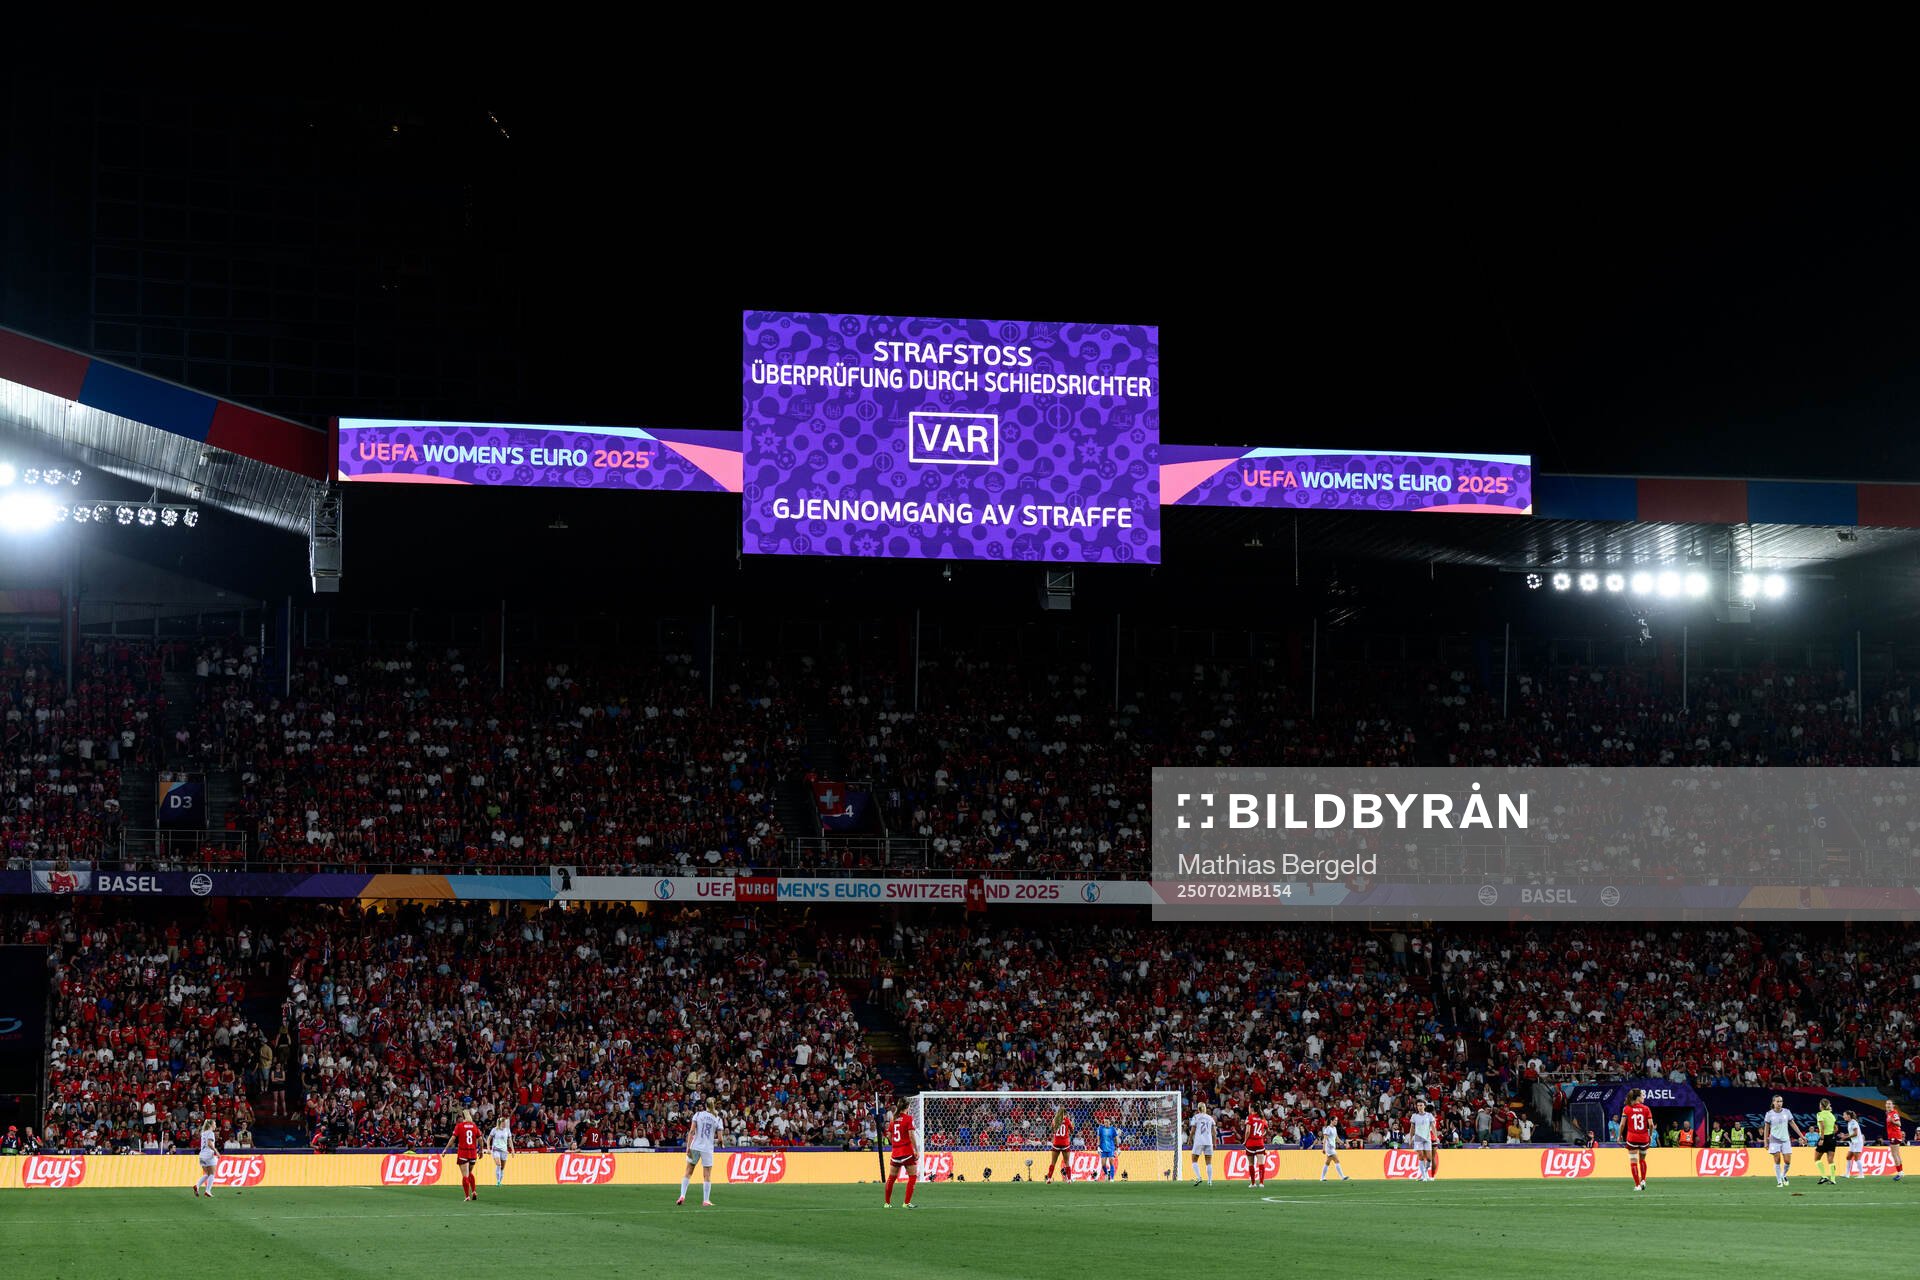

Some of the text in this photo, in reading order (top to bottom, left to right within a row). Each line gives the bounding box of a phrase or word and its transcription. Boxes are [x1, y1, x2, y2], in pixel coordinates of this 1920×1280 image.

[873, 341, 1033, 367] STRAFSTOSS
[751, 359, 1152, 397] ÜBERPRÜFUNG DURCH SCHIEDSRICHTER
[917, 423, 989, 453] VAR
[359, 442, 419, 462] UEFA
[423, 444, 524, 465] WOMEN'S
[530, 448, 588, 467] EURO
[1243, 469, 1298, 488] UEFA
[1301, 471, 1394, 491] WOMEN'S
[1399, 473, 1452, 492] EURO
[772, 497, 1133, 529] GJENNOMGANG AV STRAFFE
[170, 794, 193, 809] D3
[98, 876, 162, 893] BASEL
[697, 882, 736, 898] UEF
[834, 883, 882, 899] EURO
[1015, 884, 1059, 900] 2025
[737, 882, 775, 896] TURGI
[1521, 888, 1577, 904] BASEL
[893, 1123, 901, 1142] 5
[1252, 1121, 1263, 1136] 14
[1631, 1113, 1645, 1130] 13
[466, 1129, 473, 1145] 8
[591, 1132, 599, 1144] 12
[26, 1155, 83, 1188] Lay's
[384, 1155, 439, 1186] Lay's
[559, 1153, 613, 1184] Lay's
[730, 1152, 783, 1184] Lay's
[1544, 1149, 1592, 1179] Lay's
[1699, 1149, 1747, 1177] Lay's
